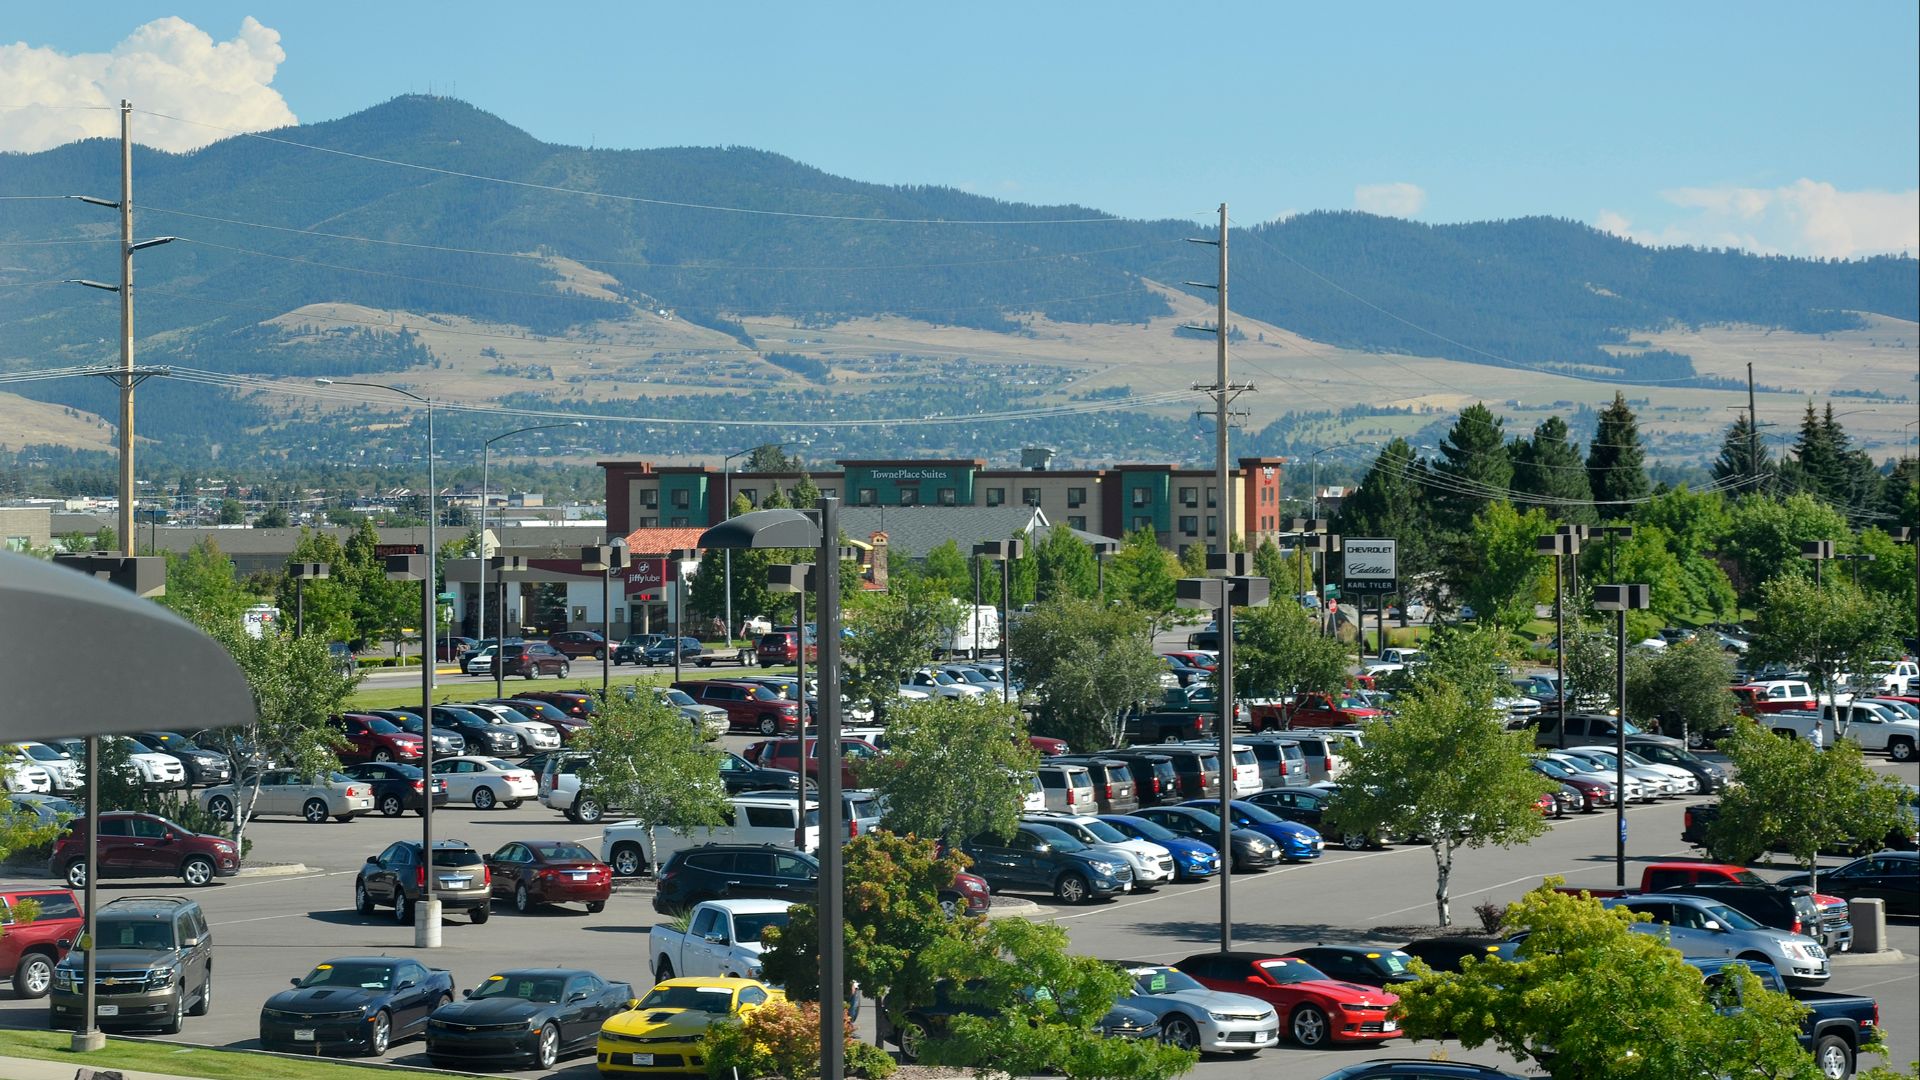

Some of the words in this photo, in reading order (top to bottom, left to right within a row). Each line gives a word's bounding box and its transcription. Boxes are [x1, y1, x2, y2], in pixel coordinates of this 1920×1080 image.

[870, 469, 920, 479] TownePlace
[921, 469, 947, 479] Suites
[1349, 562, 1391, 575] Cadillac
[628, 574, 645, 584] jiffy
[645, 574, 660, 582] lube
